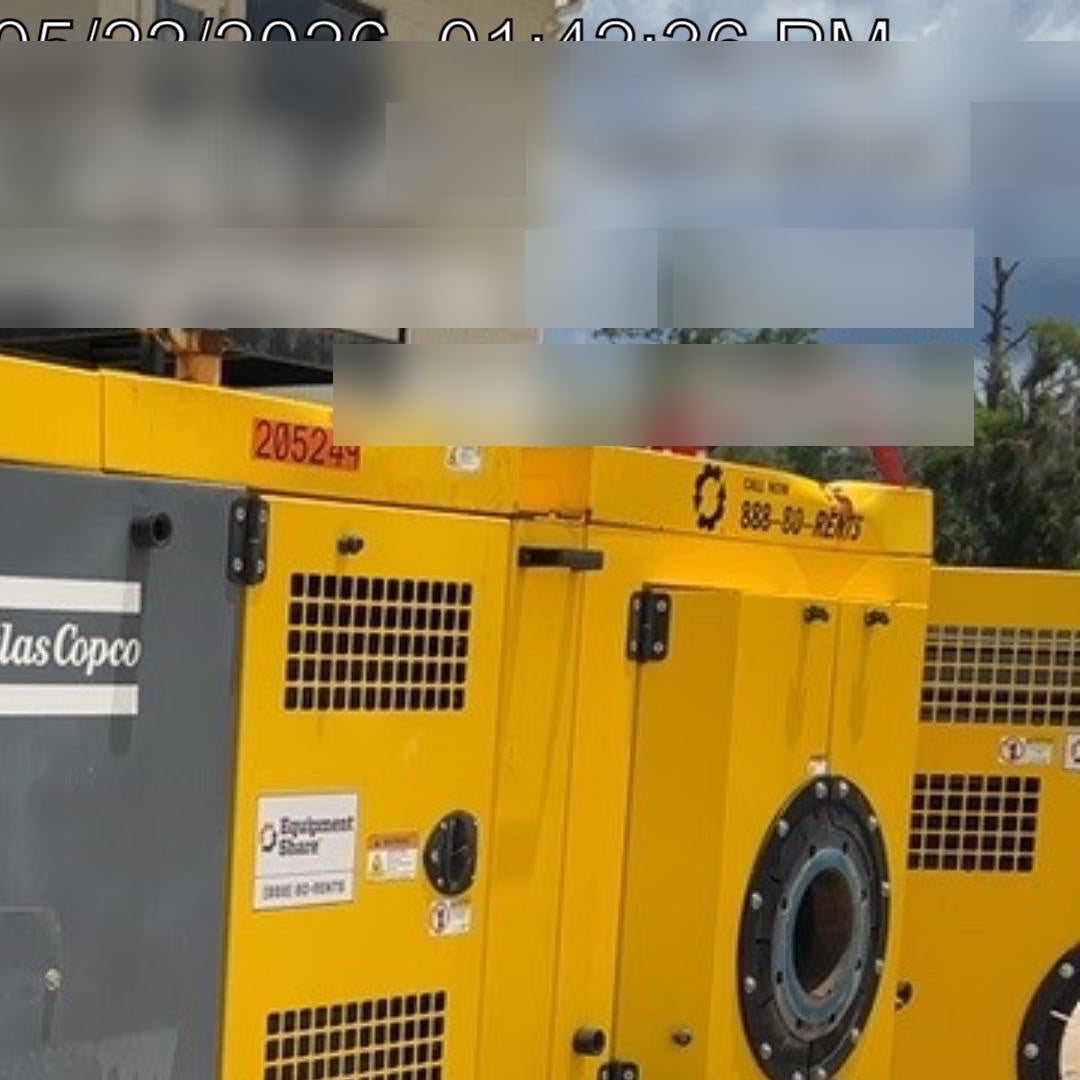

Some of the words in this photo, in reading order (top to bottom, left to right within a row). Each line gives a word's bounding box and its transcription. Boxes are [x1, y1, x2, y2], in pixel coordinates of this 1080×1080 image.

[53, 622, 142, 677] Copco
[280, 815, 354, 838] Equipment
[279, 838, 320, 856] Share
